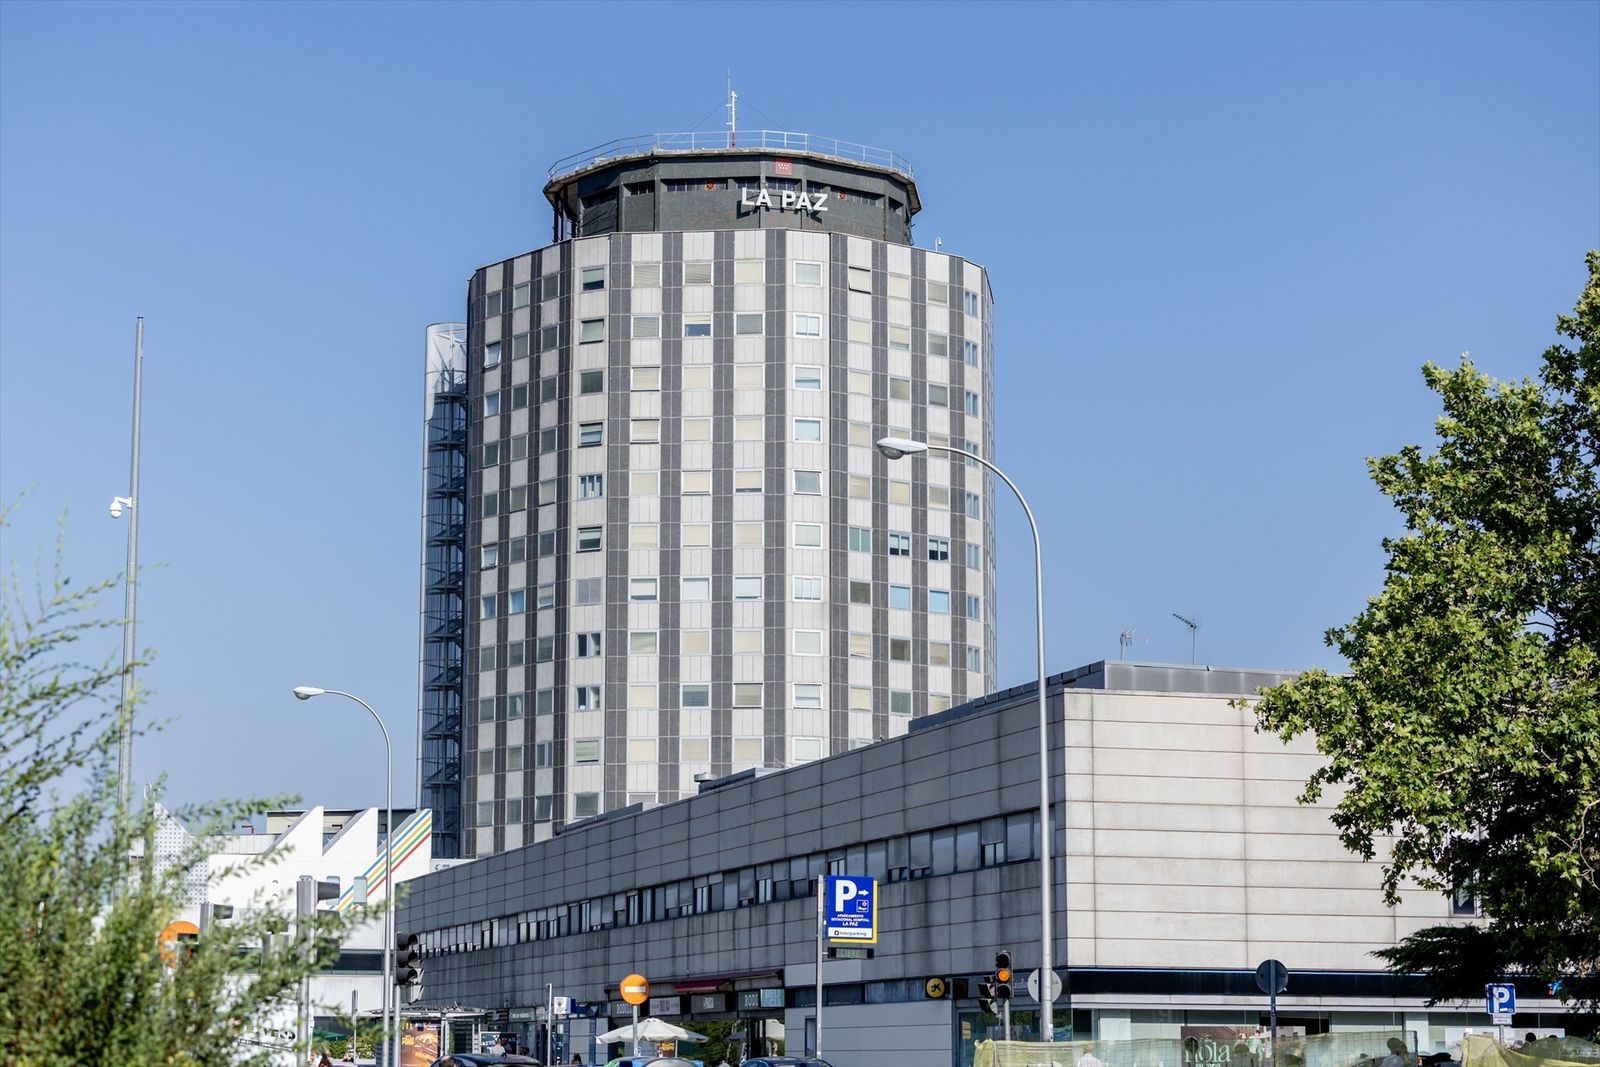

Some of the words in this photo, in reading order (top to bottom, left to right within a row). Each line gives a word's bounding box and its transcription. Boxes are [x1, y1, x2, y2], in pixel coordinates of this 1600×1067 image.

[742, 187, 773, 207] LA
[782, 190, 828, 211] PAZ
[835, 879, 857, 912] P
[1493, 987, 1510, 1013] P
